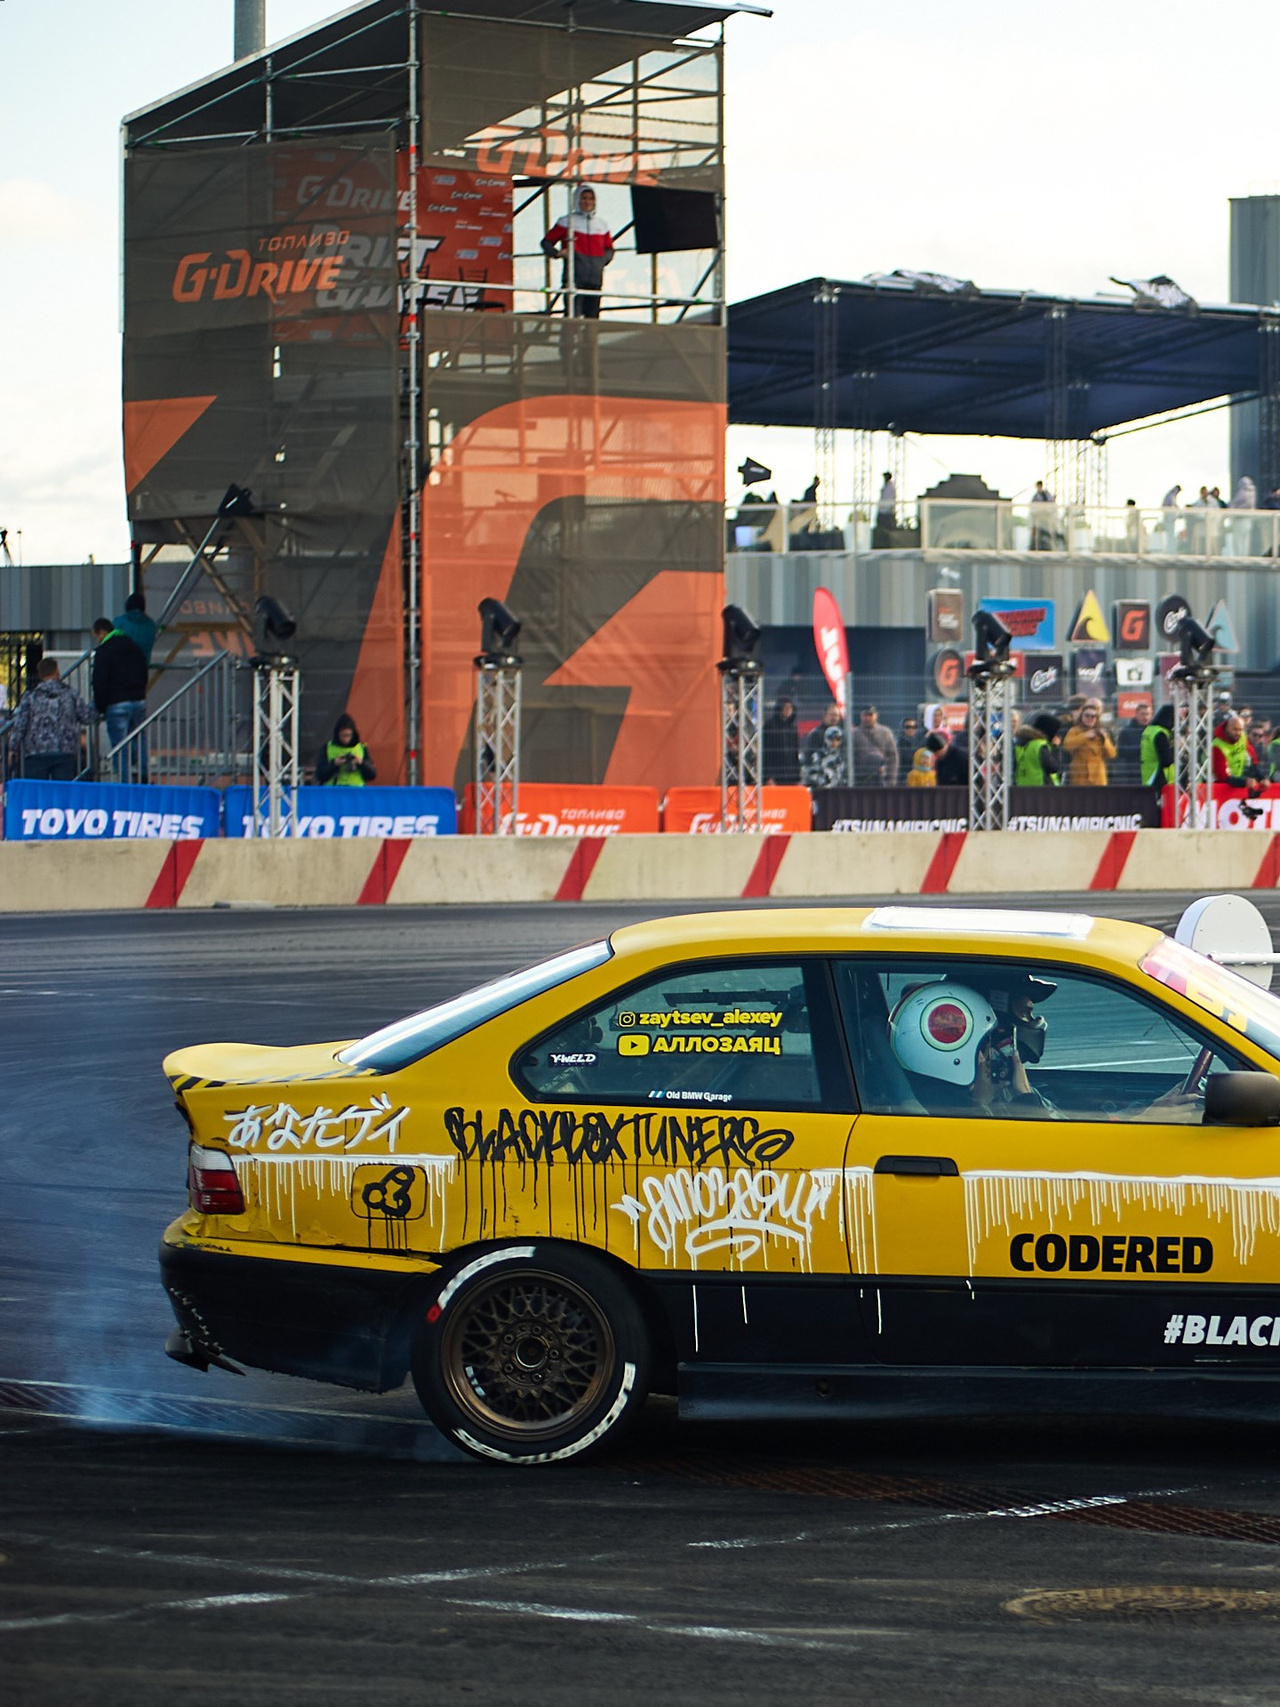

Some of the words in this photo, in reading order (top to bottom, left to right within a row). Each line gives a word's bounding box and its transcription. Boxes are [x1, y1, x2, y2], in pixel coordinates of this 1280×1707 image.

[22, 808, 108, 836] TOYO
[113, 809, 204, 838] TIRES
[339, 815, 439, 838] TIRES
[639, 1009, 783, 1029] zaytsev_alexey
[652, 1036, 781, 1055] АЛЛОЗАЯЦ
[666, 1091, 680, 1100] Old
[681, 1091, 703, 1101] BMW
[703, 1092, 733, 1102] Garage
[1010, 1233, 1213, 1273] CODERED
